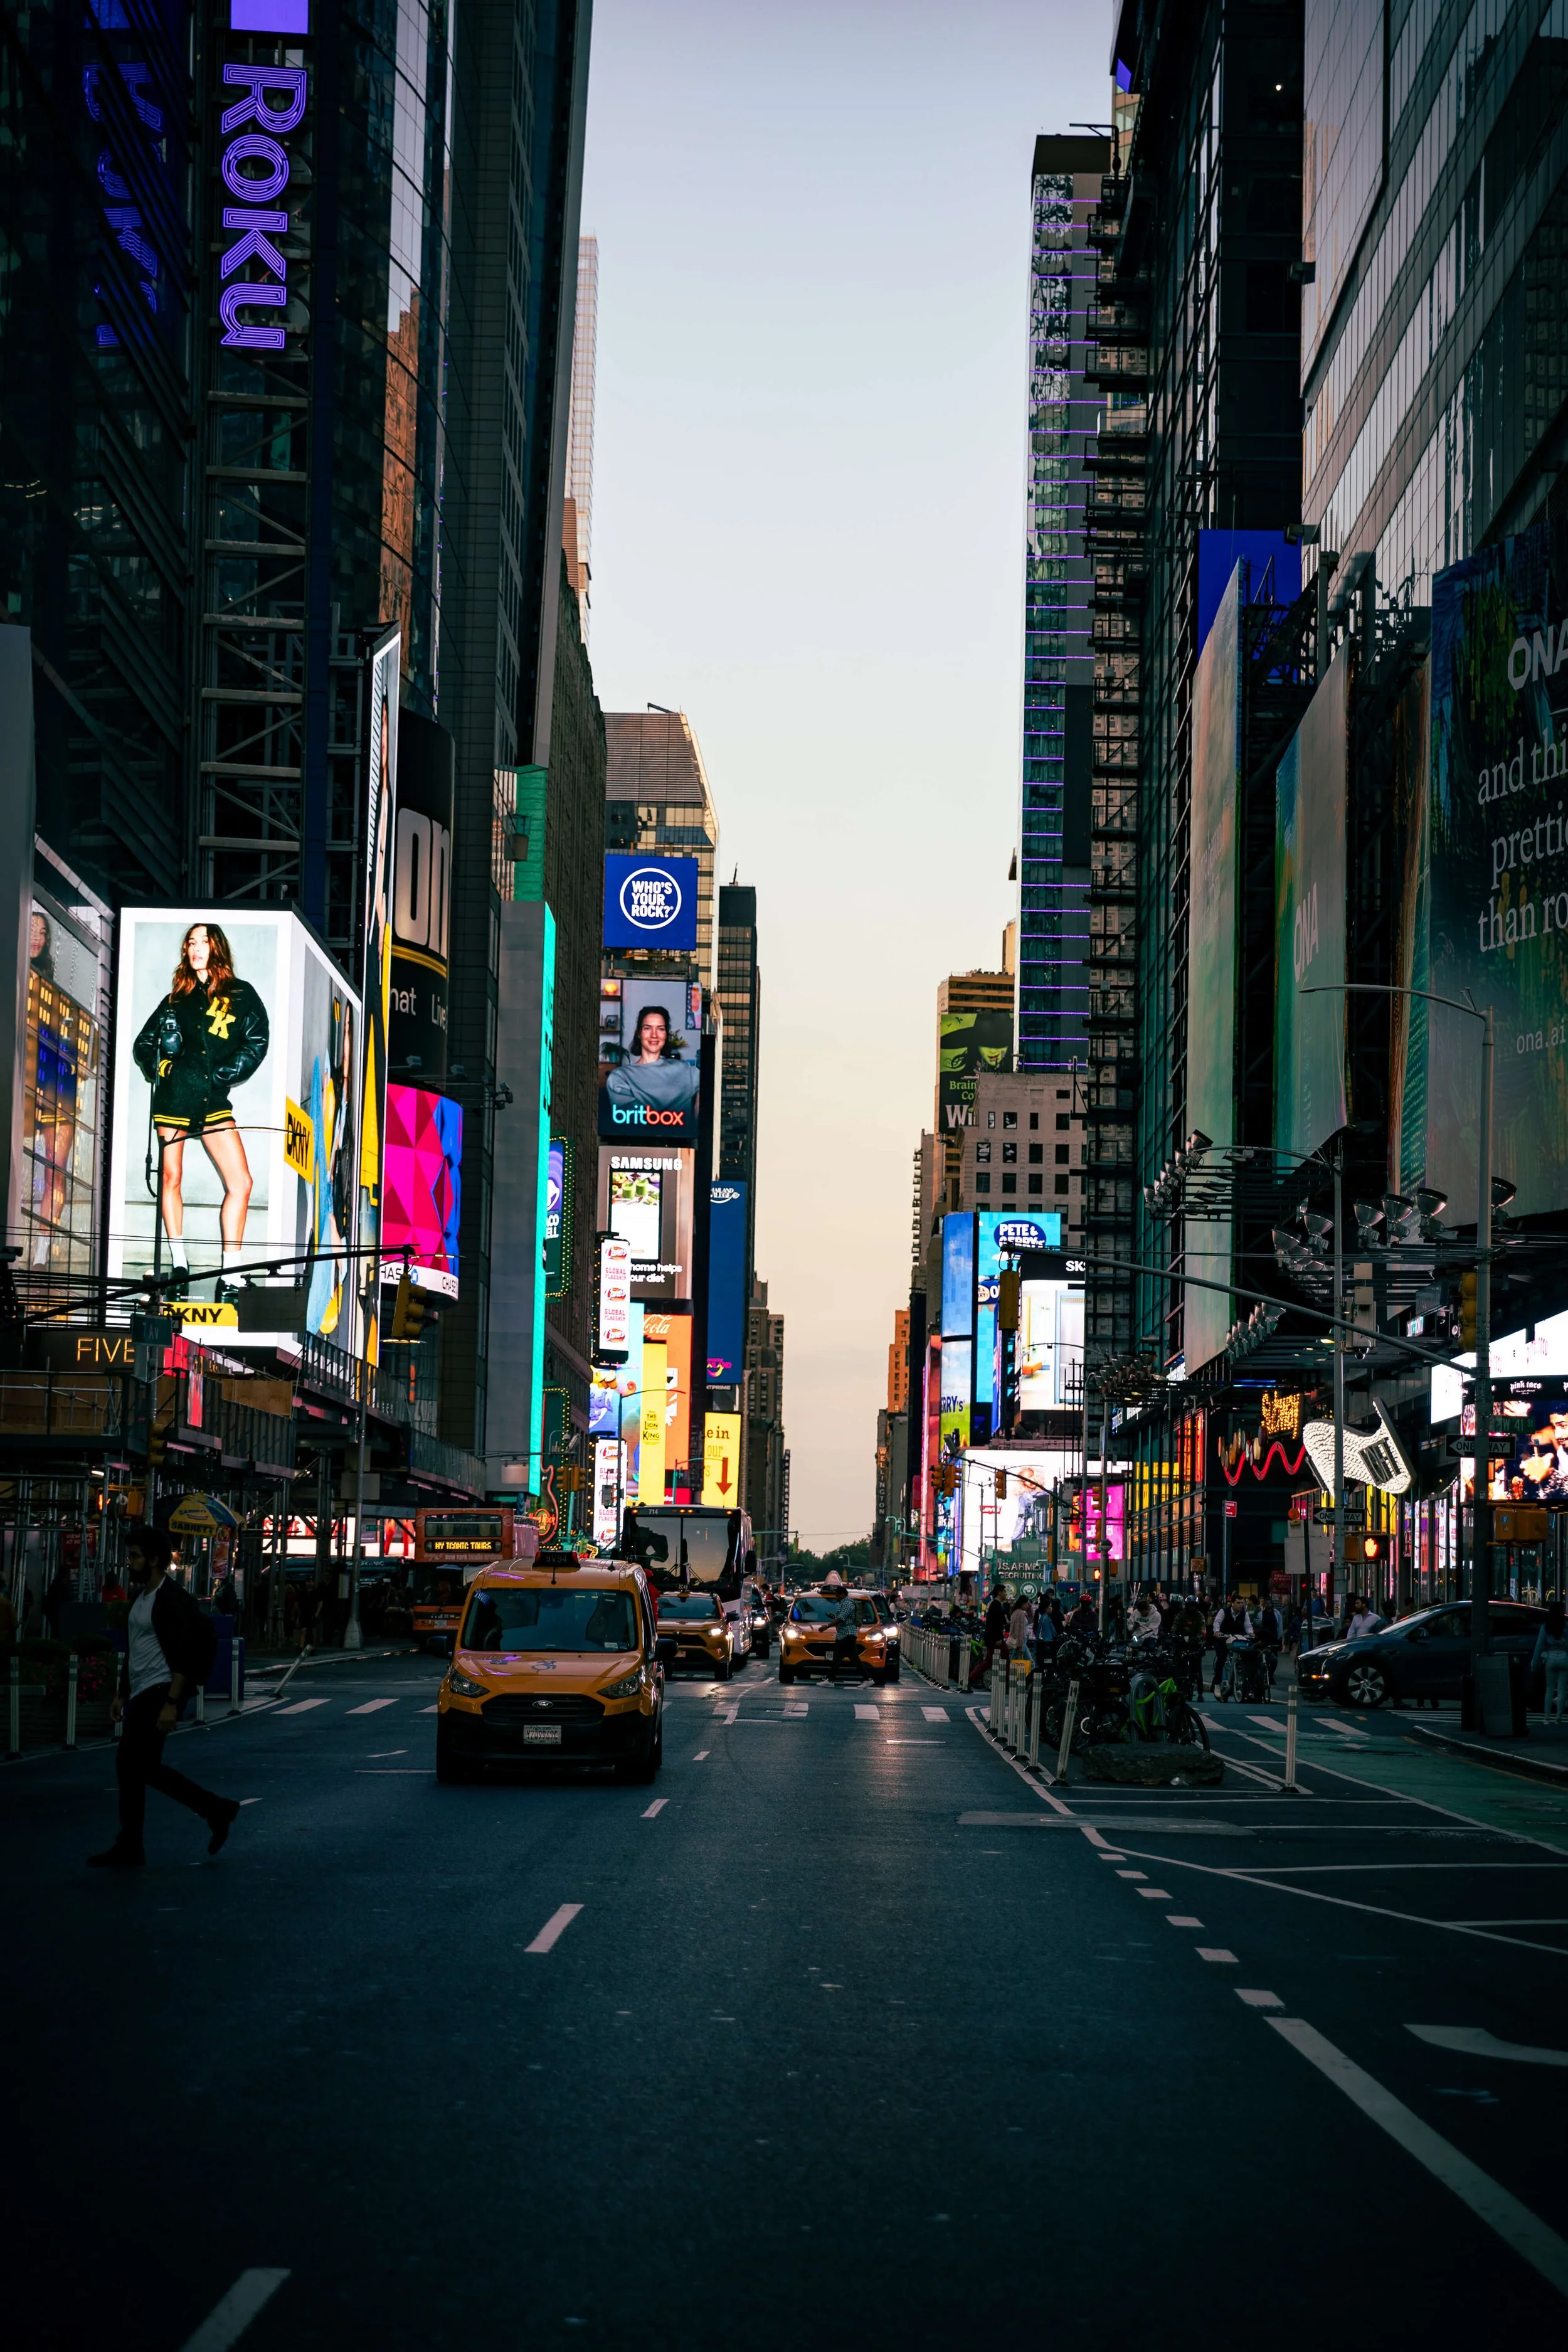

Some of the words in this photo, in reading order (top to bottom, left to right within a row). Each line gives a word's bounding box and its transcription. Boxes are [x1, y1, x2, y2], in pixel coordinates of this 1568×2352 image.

[1477, 736, 1525, 805] and
[1491, 800, 1568, 890] pretti
[632, 880, 672, 895] WHO'S
[631, 892, 665, 906] YOUR
[1478, 896, 1537, 953] than
[1294, 882, 1318, 982] ONA
[1517, 1018, 1566, 1055] ona.ai
[950, 1080, 977, 1089] Brain
[961, 1091, 975, 1100] Co
[612, 1104, 684, 1126] britbox
[287, 1111, 310, 1170] DKNY
[611, 1156, 682, 1171] SAMSUNG
[999, 1223, 1029, 1236] PETE
[1030, 1226, 1039, 1236] &
[657, 1263, 683, 1274] helps
[1066, 1260, 1086, 1272] SK
[646, 1273, 665, 1283] diet
[644, 1314, 672, 1335] Cola
[77, 1338, 135, 1363] FIVE
[1510, 1380, 1525, 1394] pink
[1526, 1381, 1542, 1389] taco
[1514, 1419, 1523, 1431] 41
[706, 1429, 714, 1439] e
[716, 1426, 729, 1439] in
[707, 1444, 723, 1458] our
[1456, 1441, 1475, 1452] ONE
[879, 1447, 887, 1515] WELLINGTON
[1320, 1512, 1335, 1520] ONE
[172, 1521, 215, 1534] SABRETT
[546, 1554, 568, 1563] 9V94
